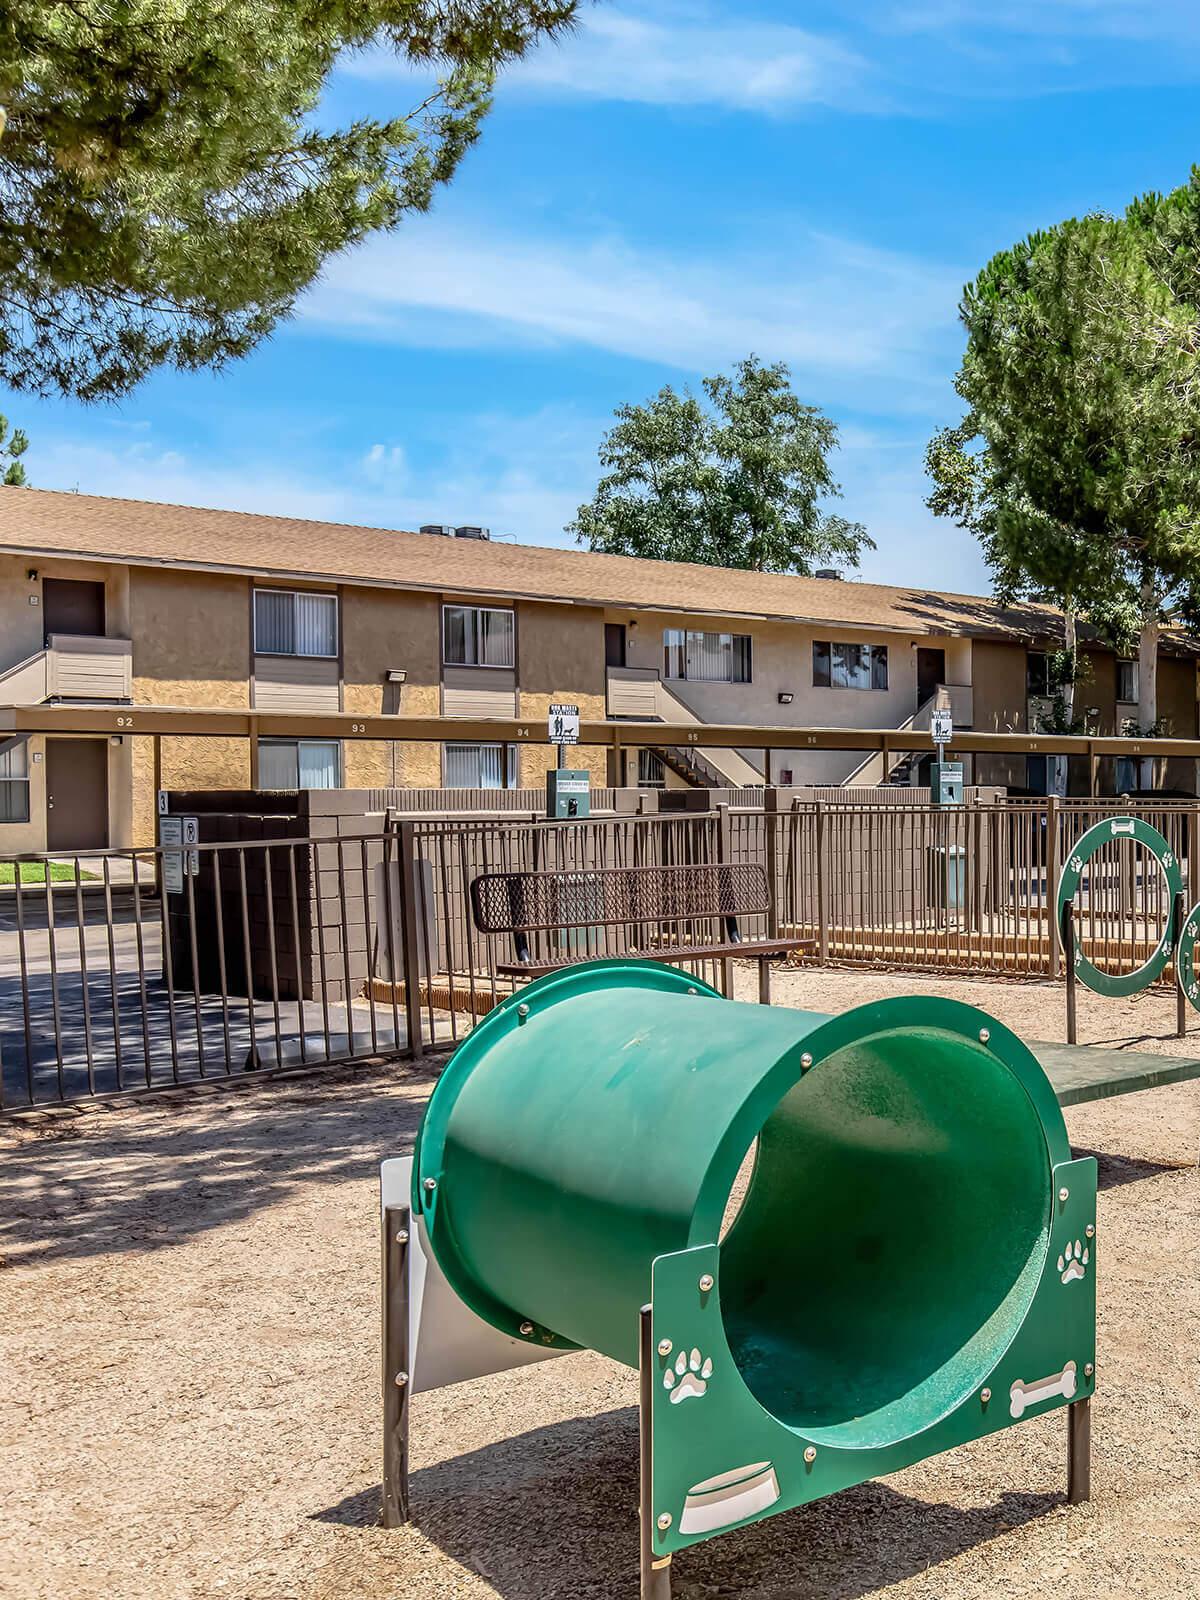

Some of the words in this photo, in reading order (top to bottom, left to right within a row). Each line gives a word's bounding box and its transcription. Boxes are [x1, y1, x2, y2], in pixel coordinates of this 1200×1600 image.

[117, 717, 133, 727] 92
[352, 724, 366, 733] 93
[517, 728, 529, 737] 94
